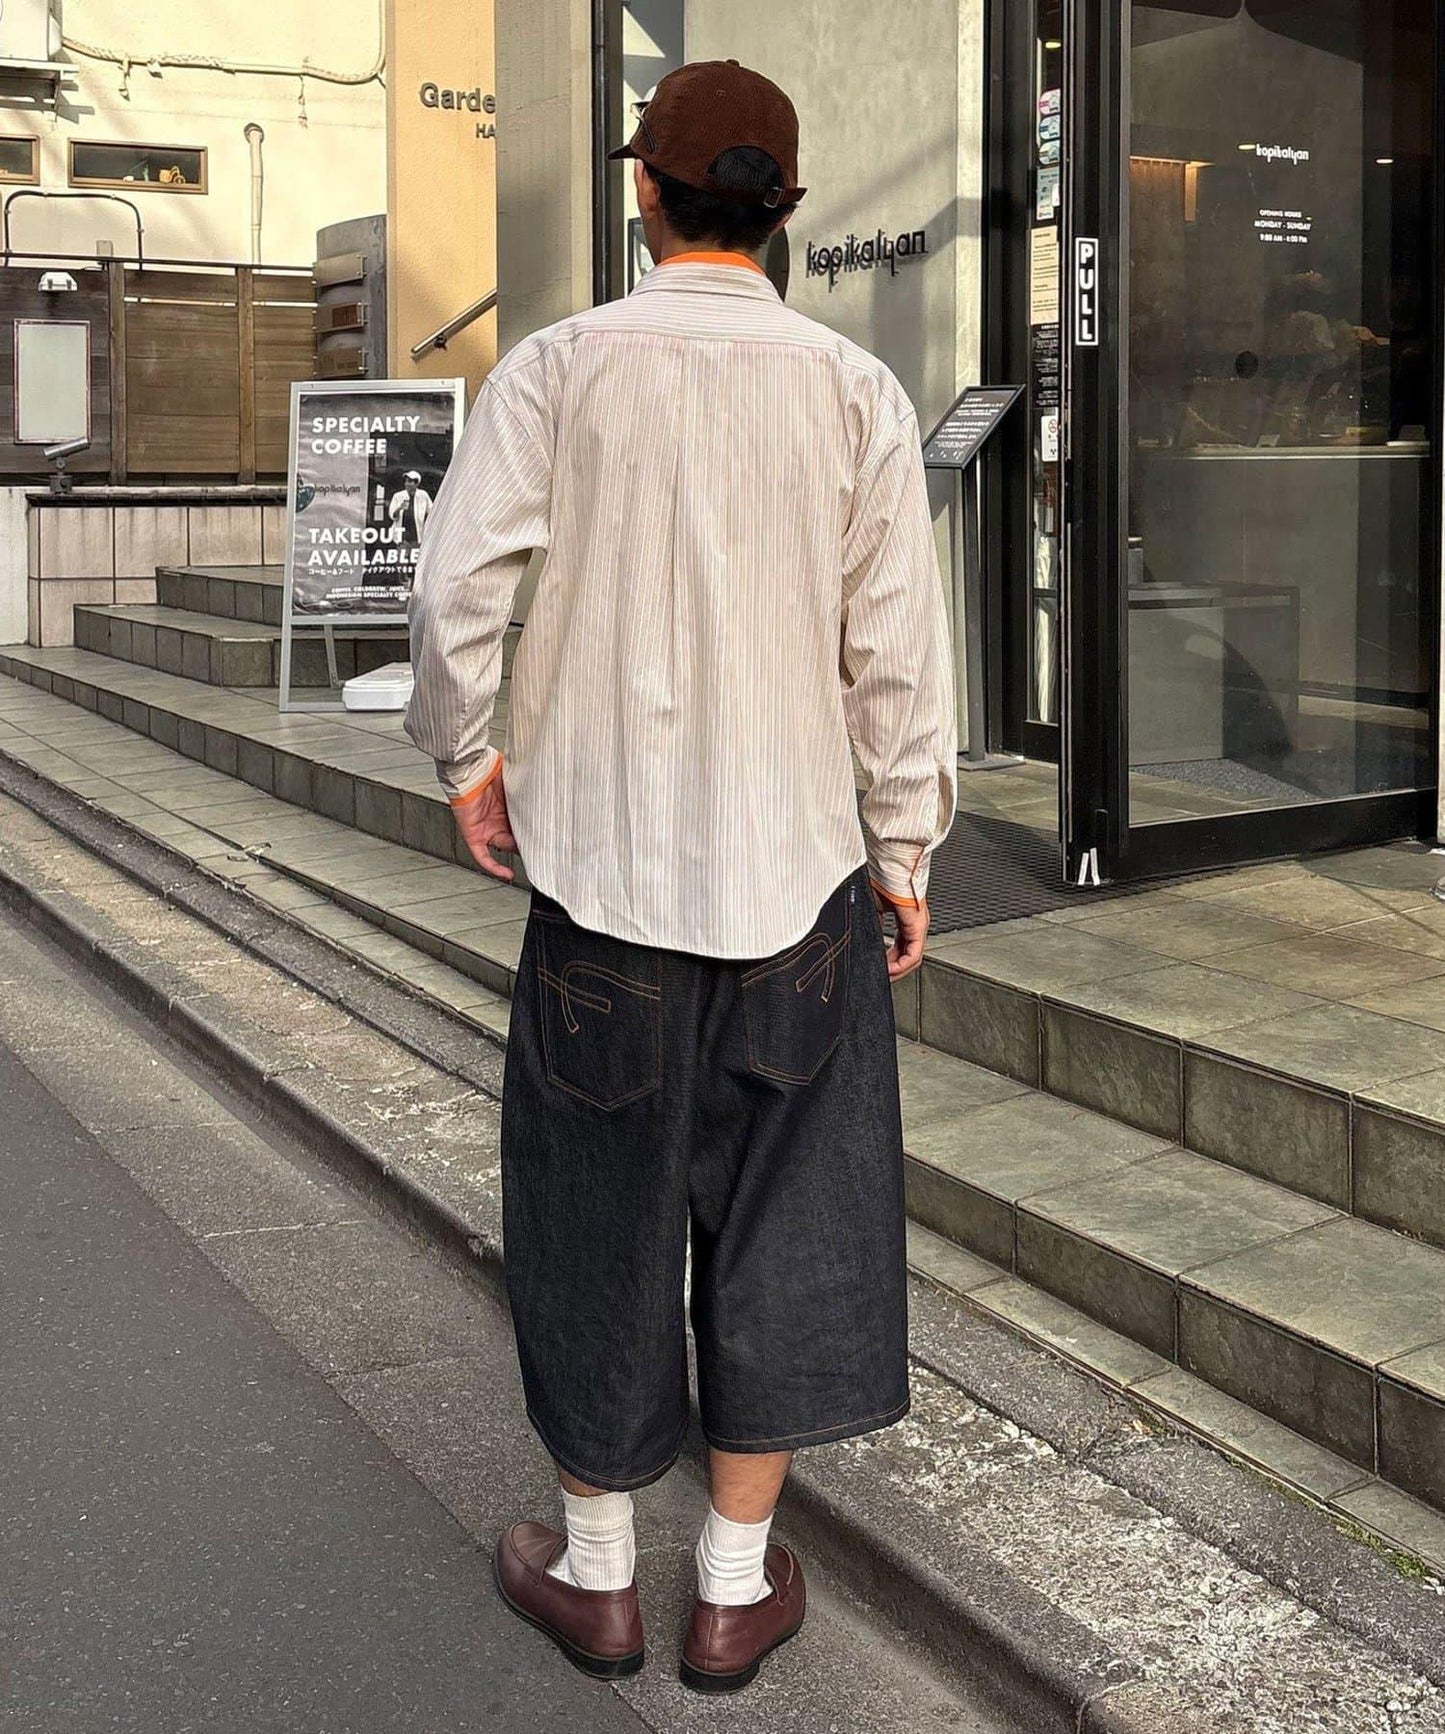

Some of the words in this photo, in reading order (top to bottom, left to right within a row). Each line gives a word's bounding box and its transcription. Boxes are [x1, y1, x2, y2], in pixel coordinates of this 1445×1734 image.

[420, 82, 495, 114] Garde
[1254, 220, 1281, 228] MONDAY
[1286, 222, 1311, 230] SUNDAY
[1080, 243, 1094, 340] PULL
[312, 416, 420, 433] SPECIALTY
[311, 438, 387, 454] COFFEE
[308, 528, 405, 544] TAKEOUT
[307, 549, 420, 566] AVAILABLE
